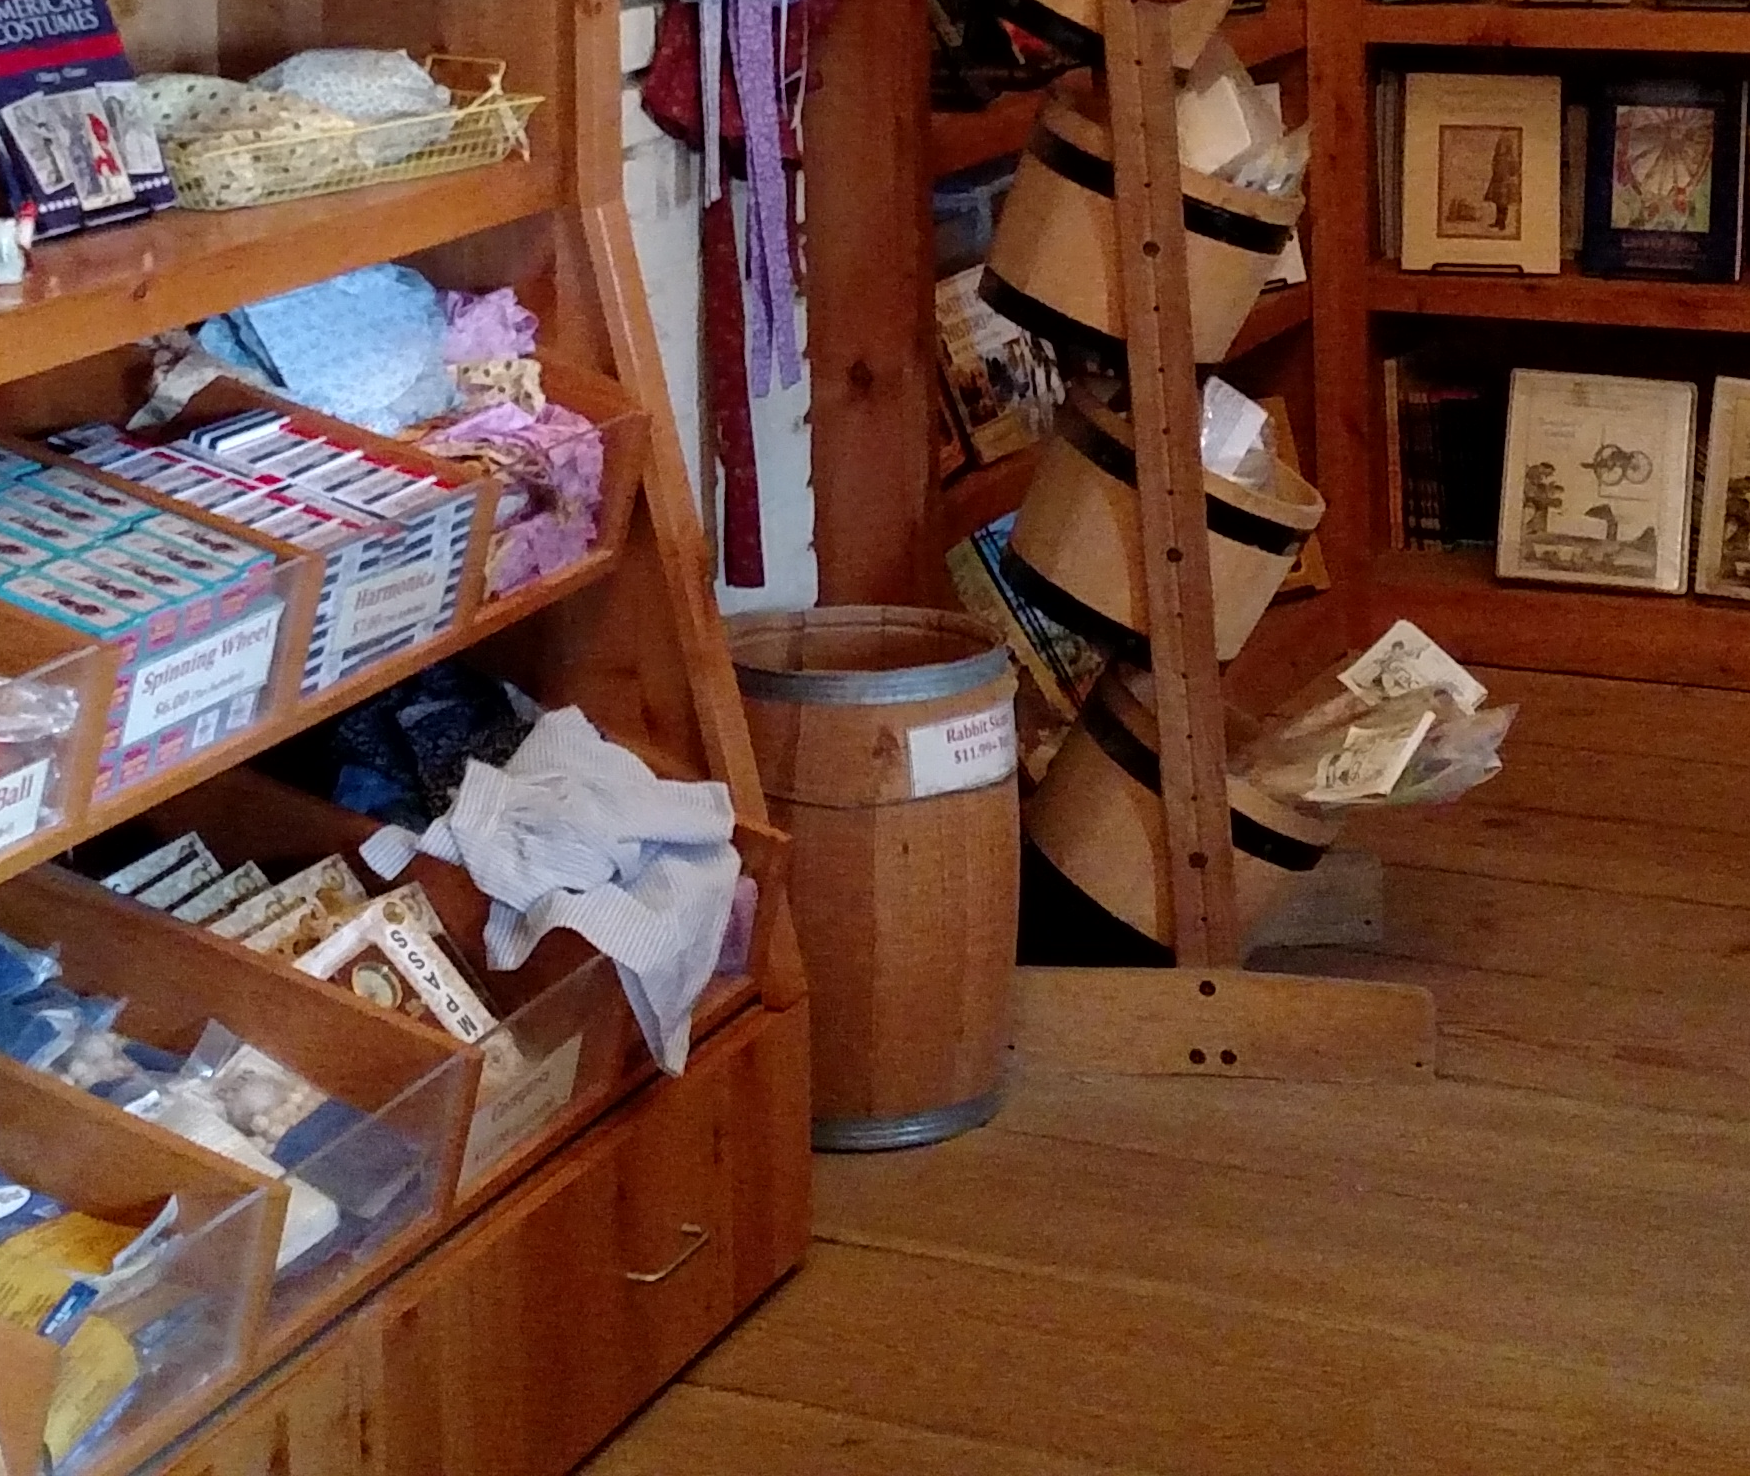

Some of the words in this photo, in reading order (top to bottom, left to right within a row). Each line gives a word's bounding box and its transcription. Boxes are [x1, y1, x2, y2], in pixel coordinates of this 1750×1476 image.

[354, 571, 436, 612] Harmonica
[141, 646, 218, 697] Spinning
[221, 619, 271, 658] Wheel
[946, 721, 989, 743] Rabbit
